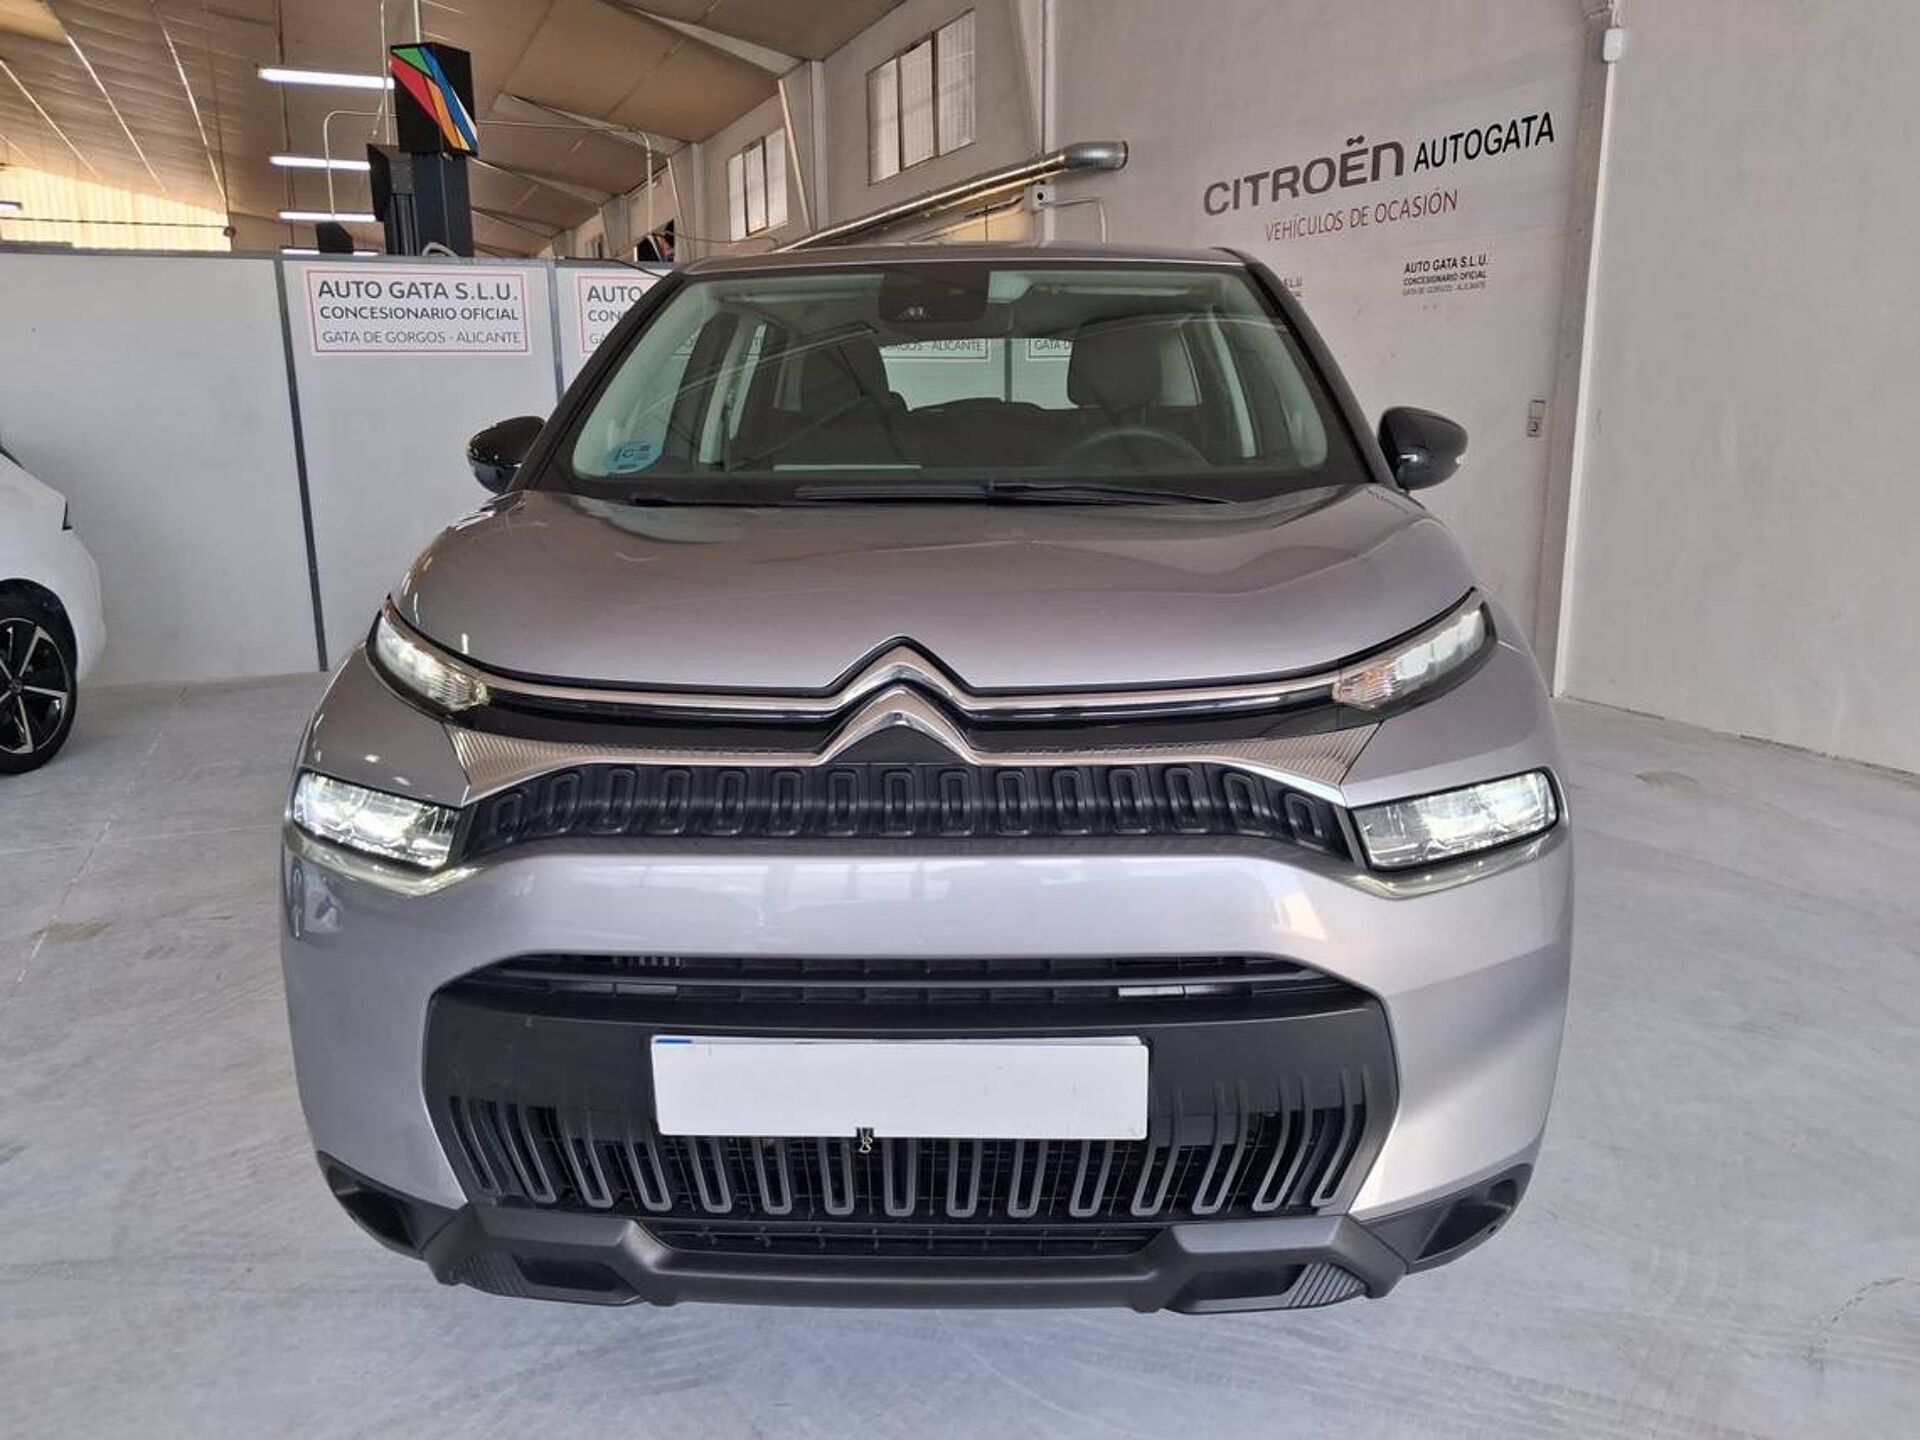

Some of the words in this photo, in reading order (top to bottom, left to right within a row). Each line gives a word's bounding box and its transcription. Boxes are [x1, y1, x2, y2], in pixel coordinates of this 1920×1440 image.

[1414, 112, 1554, 172] AUTOGATA
[1266, 210, 1343, 241] VEHÍCULOS
[1350, 206, 1370, 228] DE
[1375, 188, 1458, 223] OCASIÓN
[1404, 261, 1430, 274] AUTO
[1433, 258, 1458, 270] GATA
[318, 281, 382, 299] AUTO
[389, 282, 449, 299] GATA
[455, 283, 518, 300] S.L.U.
[587, 286, 643, 302] AUTO
[320, 306, 457, 320] CONCESIONARIO
[461, 307, 519, 320] OFICIAL
[323, 331, 360, 343] GATA
[364, 332, 381, 343] DE
[386, 331, 446, 343] GORGOS
[457, 332, 521, 344] ALICANTE
